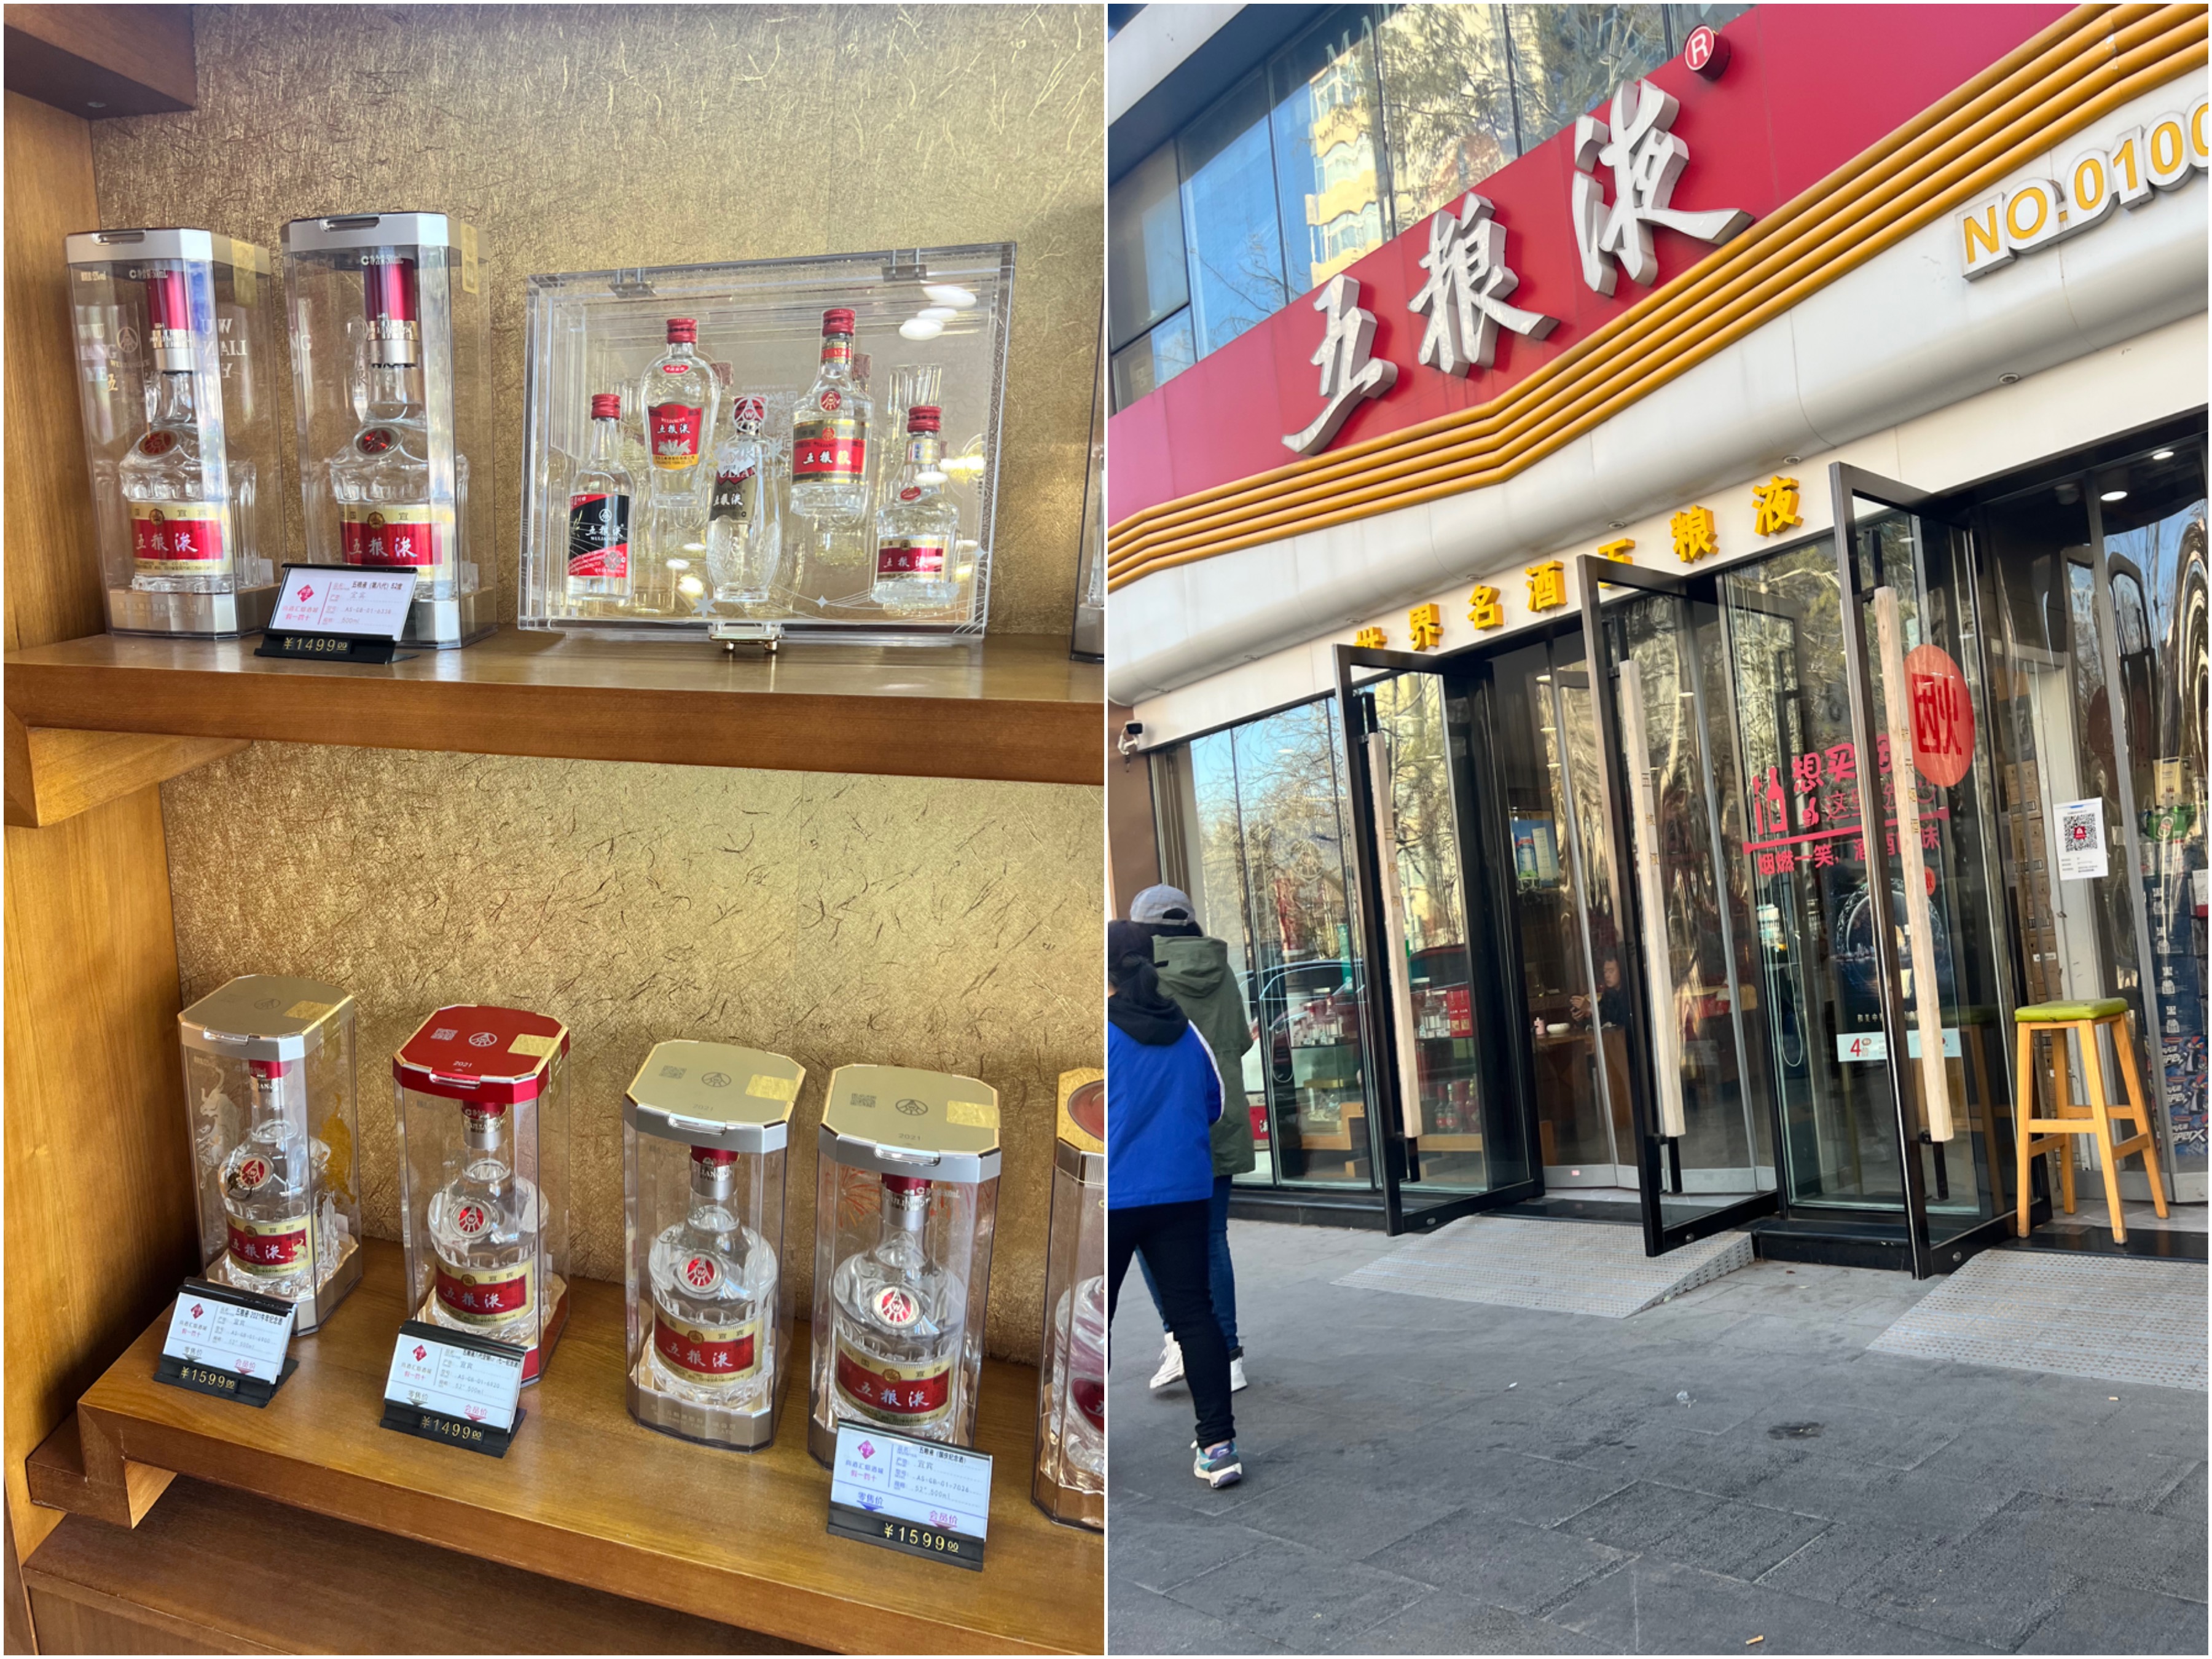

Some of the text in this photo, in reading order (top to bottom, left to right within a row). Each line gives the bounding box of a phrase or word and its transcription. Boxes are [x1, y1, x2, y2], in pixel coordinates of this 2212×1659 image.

[1282, 78, 1755, 456] 五粮液
[135, 532, 198, 553] 五粮液
[348, 536, 418, 558] 五粮液
[231, 1239, 286, 1259] 五粮液
[443, 1287, 504, 1308] 五粮液
[665, 1342, 734, 1368] 五粮液
[855, 1381, 930, 1407] 五粮液
[857, 1491, 884, 1506] 零售价
[928, 1510, 959, 1526] 会员价
